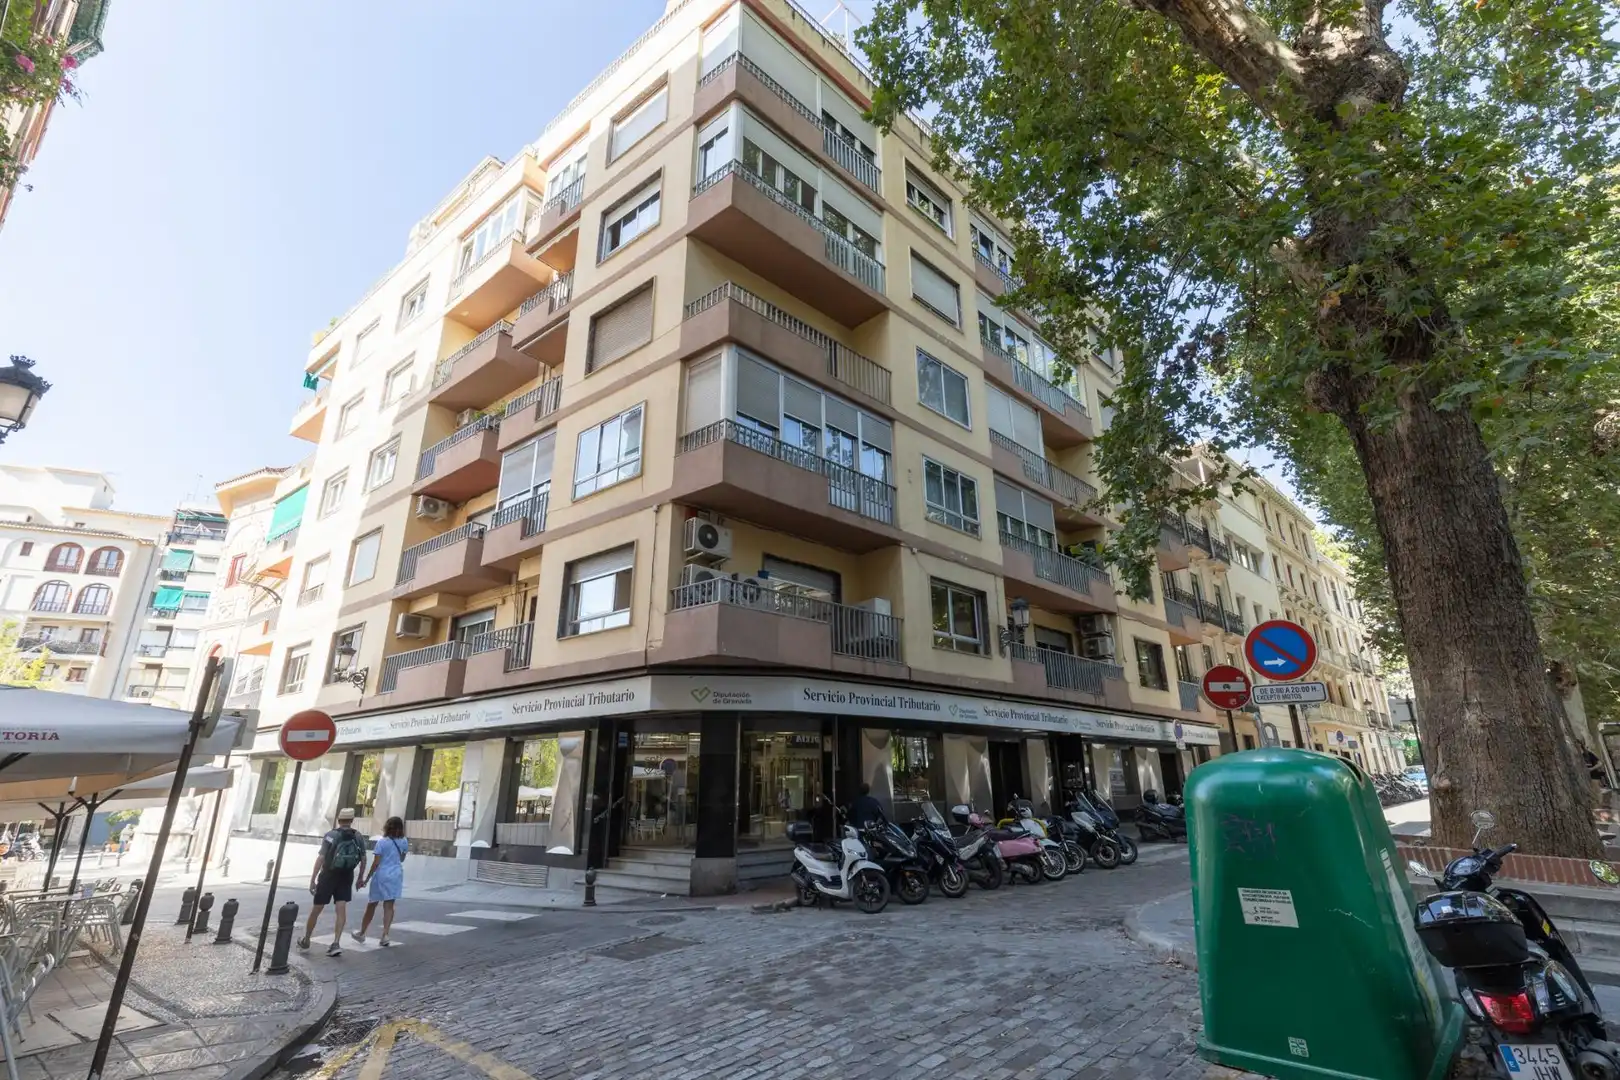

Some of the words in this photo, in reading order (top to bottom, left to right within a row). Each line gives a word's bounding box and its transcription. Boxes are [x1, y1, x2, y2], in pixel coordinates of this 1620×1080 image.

[512, 701, 542, 714] Servicio
[543, 694, 585, 711] Provincial
[587, 689, 635, 705] Tributario
[803, 687, 846, 704] Servicio
[848, 692, 896, 708] Provincial
[897, 696, 941, 712] Tributario
[440, 710, 471, 724] Tributario
[983, 705, 1009, 719] Servicio
[1010, 708, 1040, 721] Provincial
[1040, 712, 1068, 724] Tributario
[1513, 1046, 1560, 1065] 3445
[1532, 1066, 1562, 1080] JHW
